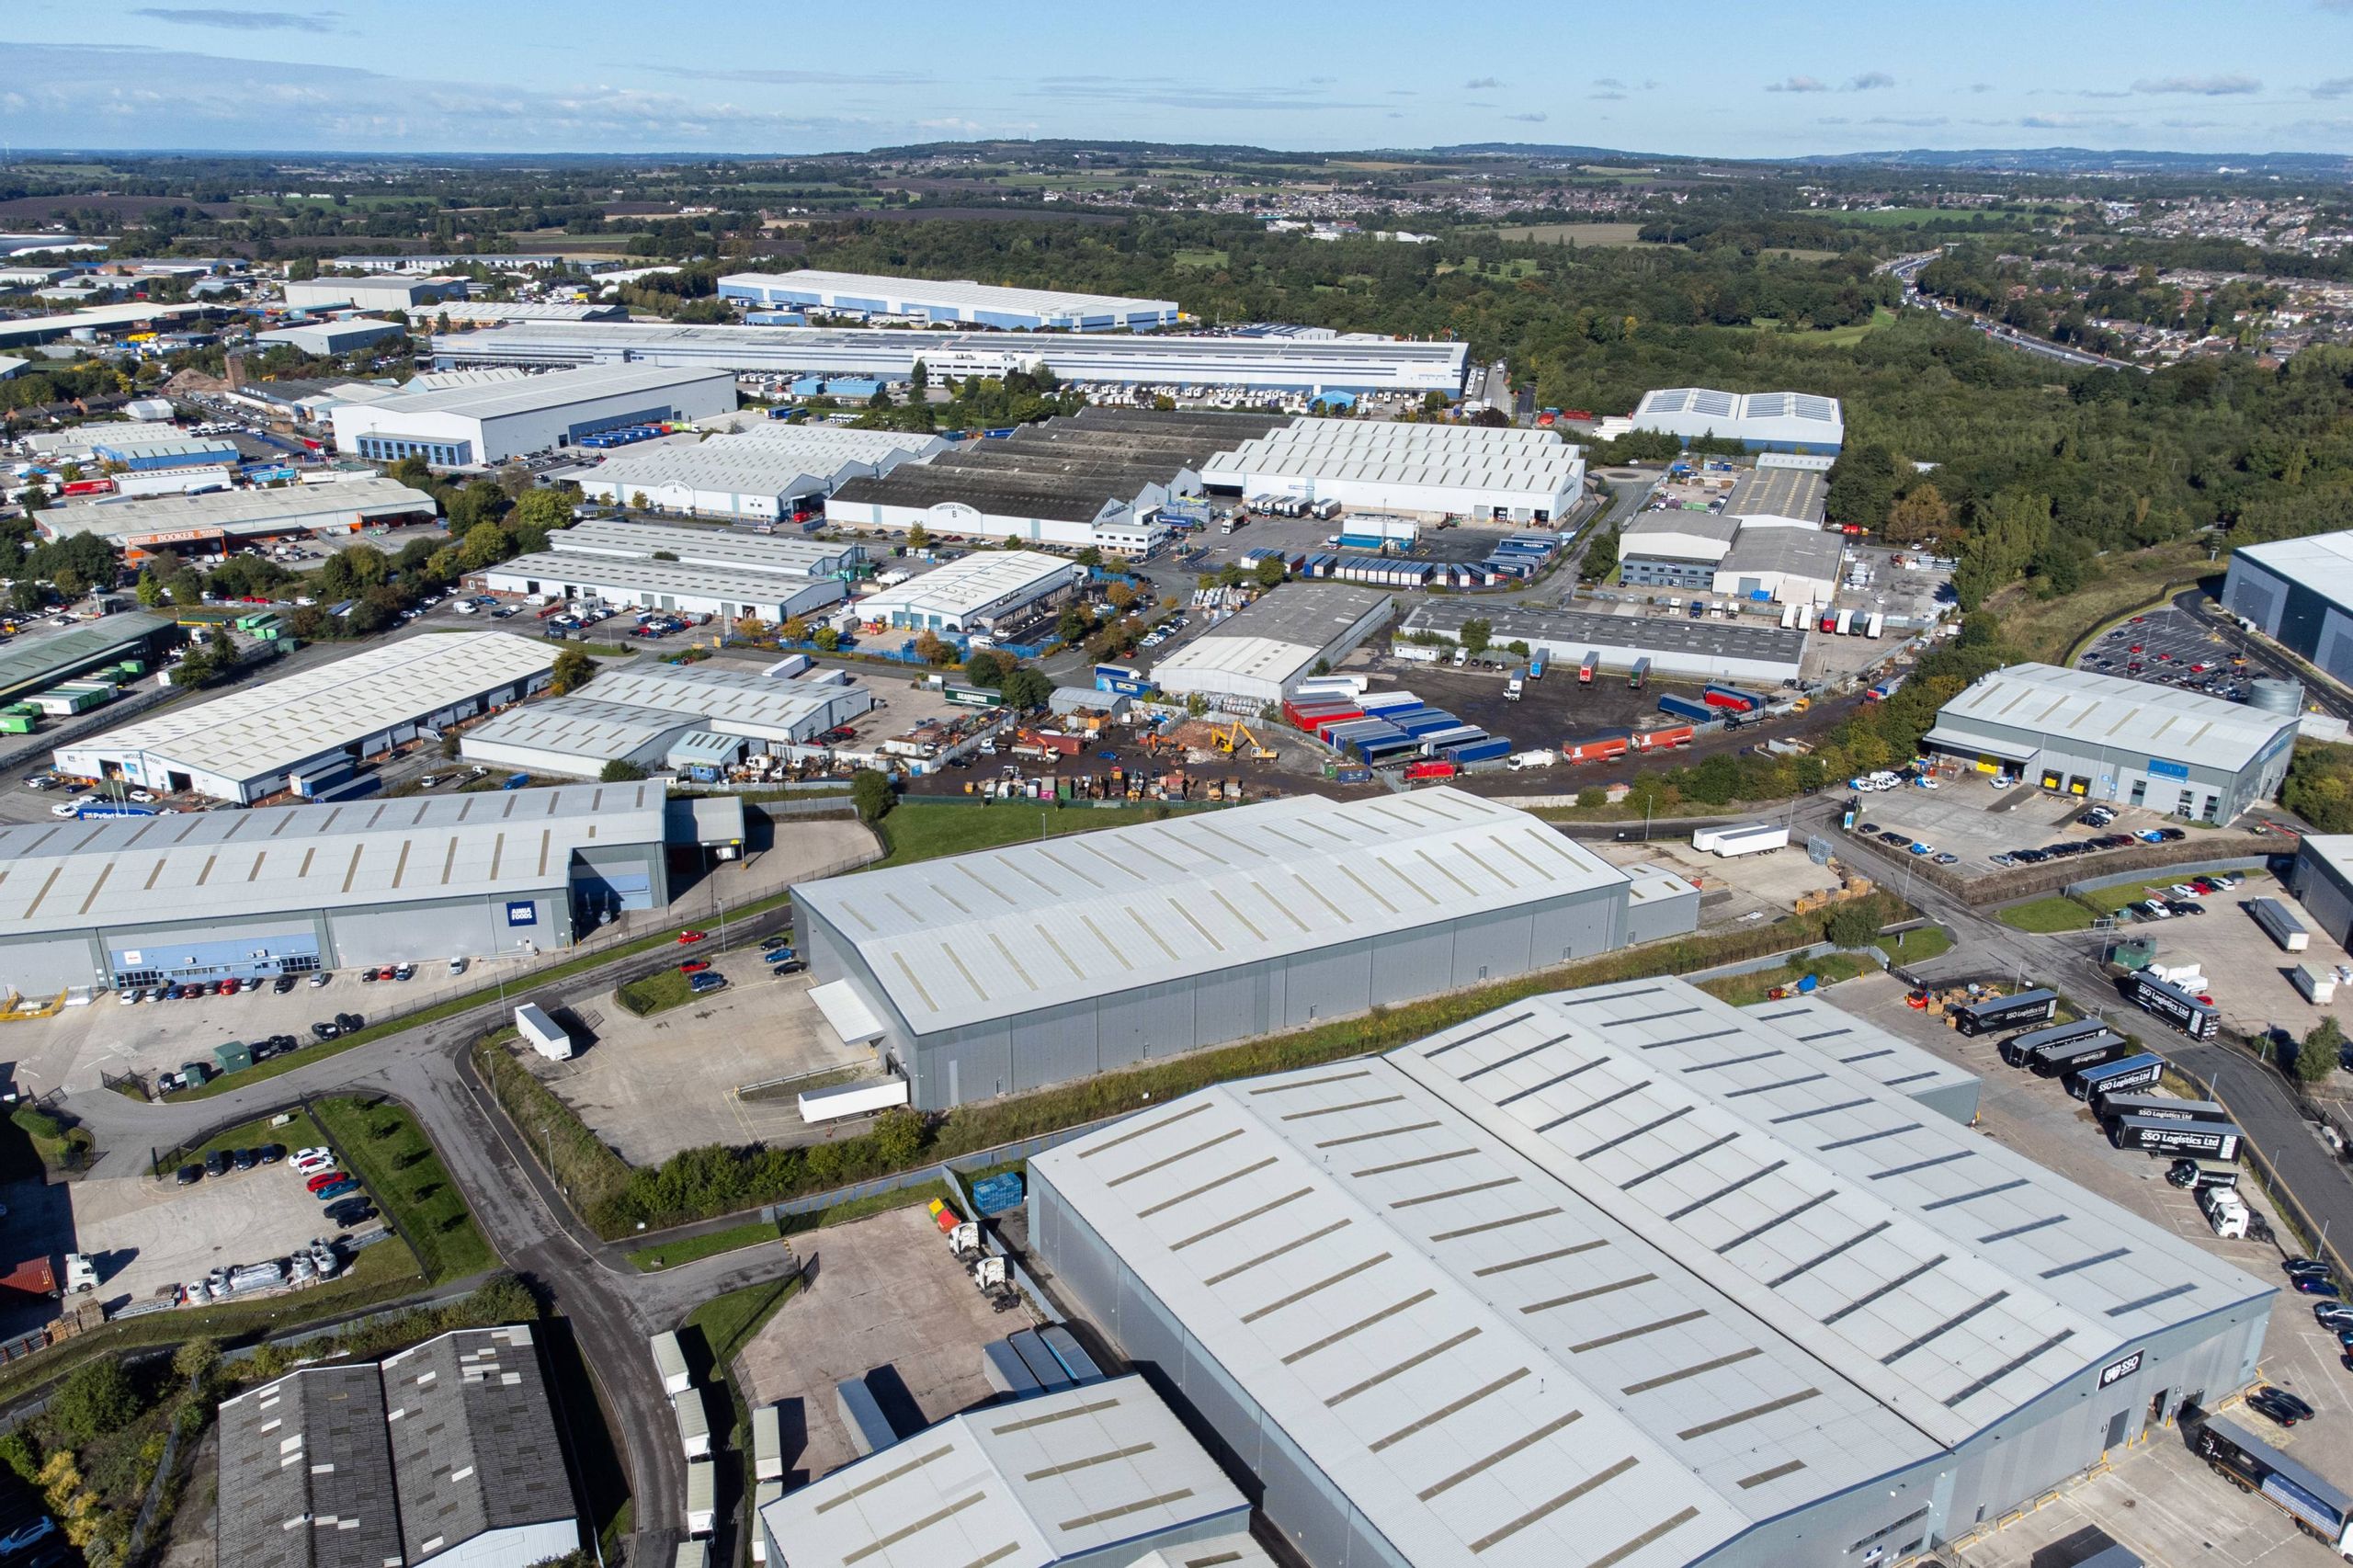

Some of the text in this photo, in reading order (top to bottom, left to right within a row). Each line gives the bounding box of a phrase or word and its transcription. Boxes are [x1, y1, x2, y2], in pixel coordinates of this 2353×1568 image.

[157, 531, 194, 542] BOOKER
[2138, 985, 2151, 996] SSO
[2152, 992, 2178, 1011] Logistics
[2178, 1006, 2189, 1017] Ltd
[2006, 1005, 2048, 1019] SSO Logistics Ltd
[2098, 1083, 2112, 1092] SSO
[2112, 1075, 2139, 1088] Logistics
[2140, 1072, 2151, 1081] Ltd
[2153, 1111, 2180, 1119] Logistics
[2141, 1132, 2160, 1142] SSO
[2162, 1134, 2201, 1145] Logistics
[2203, 1138, 2219, 1146] Ltd
[2120, 1356, 2139, 1372] SSO
